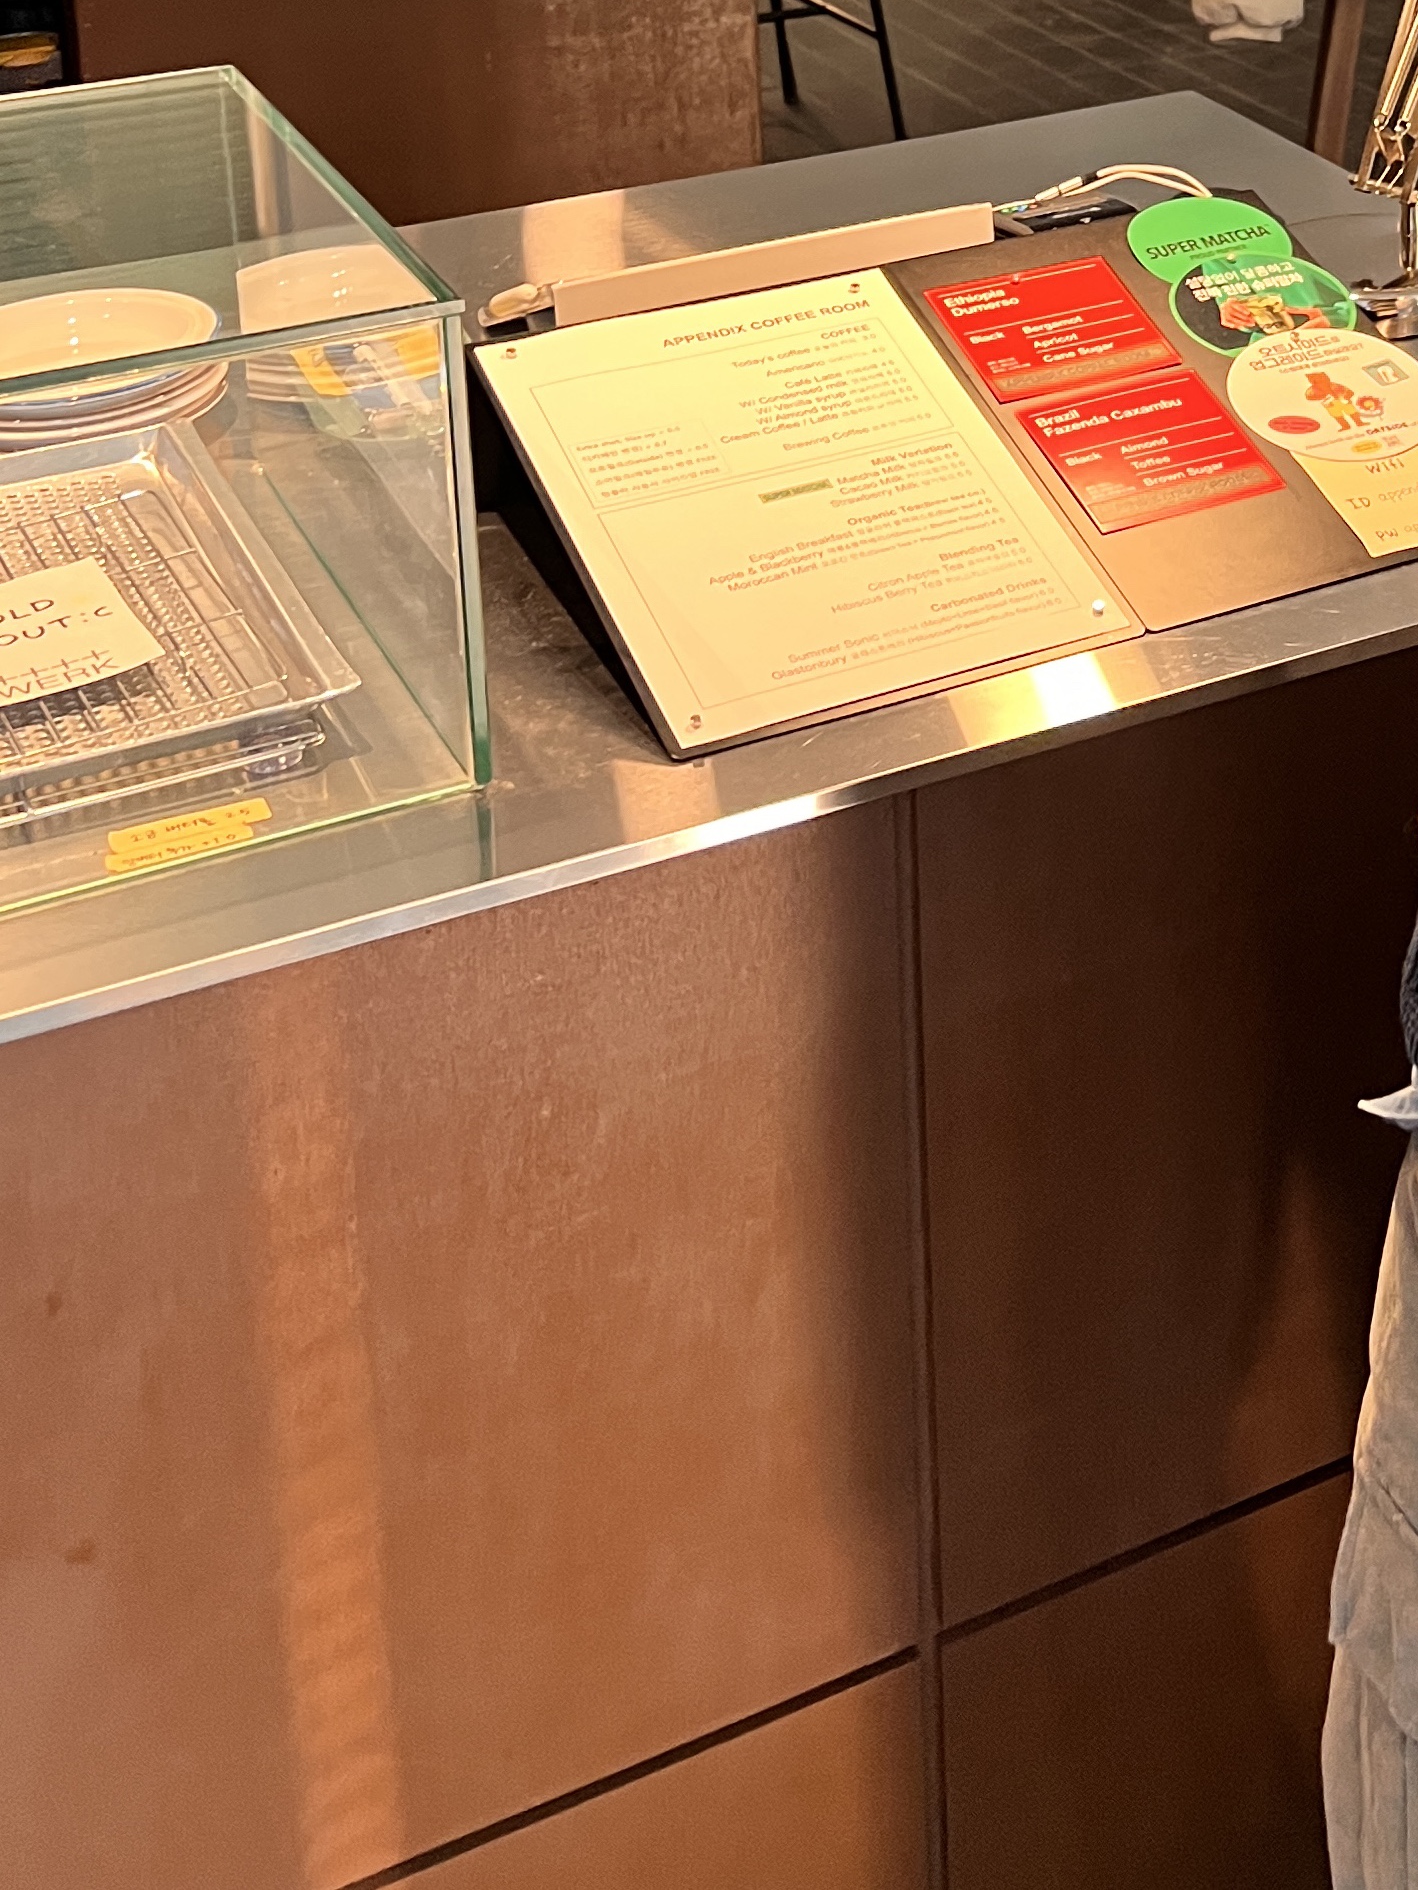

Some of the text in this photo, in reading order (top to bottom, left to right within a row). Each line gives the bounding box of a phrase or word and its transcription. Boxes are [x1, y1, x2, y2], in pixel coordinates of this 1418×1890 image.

[1146, 225, 1271, 260] SUPER MATCHA
[1240, 260, 1295, 279] 달콤하고
[943, 289, 1006, 308] Ethiopia
[950, 297, 1020, 317] Dumerso
[664, 300, 870, 348] APPENDIX COFFEE ROOM
[820, 324, 870, 340] COFFEE
[969, 316, 1083, 344] Black Bergamot
[1034, 333, 1078, 348] Apricot
[1042, 351, 1076, 362] Cane
[1077, 342, 1113, 355] Sugar
[731, 356, 774, 368] Today's
[777, 348, 810, 359] coffee
[766, 360, 825, 377] Americano
[758, 385, 823, 404] Condensed
[826, 381, 848, 390] milk
[774, 399, 813, 411] Vanilla
[815, 392, 846, 403] syrup
[776, 406, 819, 422] Almond
[820, 400, 852, 412] syrup
[1034, 409, 1080, 428] Brazil
[1043, 399, 1182, 437] Fazenda Caxambu
[720, 431, 760, 444] Cream
[762, 422, 800, 434] Coffee
[809, 413, 838, 425] Latte
[782, 436, 830, 451] Brewing
[832, 428, 870, 440] Coffee
[870, 456, 897, 466] Milk
[898, 443, 953, 459] Variation
[1065, 436, 1168, 466] Black Almond
[836, 471, 880, 485] Matcha
[881, 464, 906, 474] Milk
[1130, 456, 1170, 470] Toffee
[1142, 462, 1223, 487] Brown Sugar
[830, 482, 919, 508] Strawberry Milk
[839, 482, 878, 495] Cacao
[879, 476, 903, 485] Milk
[1346, 496, 1371, 510] ID
[847, 510, 897, 526] Organic
[748, 546, 794, 563] English
[796, 530, 854, 551] Breakfast
[938, 543, 996, 562] Blending
[996, 538, 1019, 546] Tea
[709, 571, 745, 585] Apple
[759, 551, 823, 572] Blackberry
[727, 572, 790, 592] Moroccan
[790, 562, 818, 575] Mint
[868, 578, 904, 592] Citron
[906, 569, 940, 582] Apple
[942, 563, 964, 572] Tea
[830, 595, 884, 614] Hibiscus
[884, 587, 918, 599] Berry
[920, 579, 943, 589] Tea
[930, 578, 1047, 612] Carbonated Drinks
[788, 644, 840, 663] Summer
[843, 634, 880, 648] Sonic
[0, 657, 120, 699] WERK
[771, 655, 846, 680] Glastonbury
